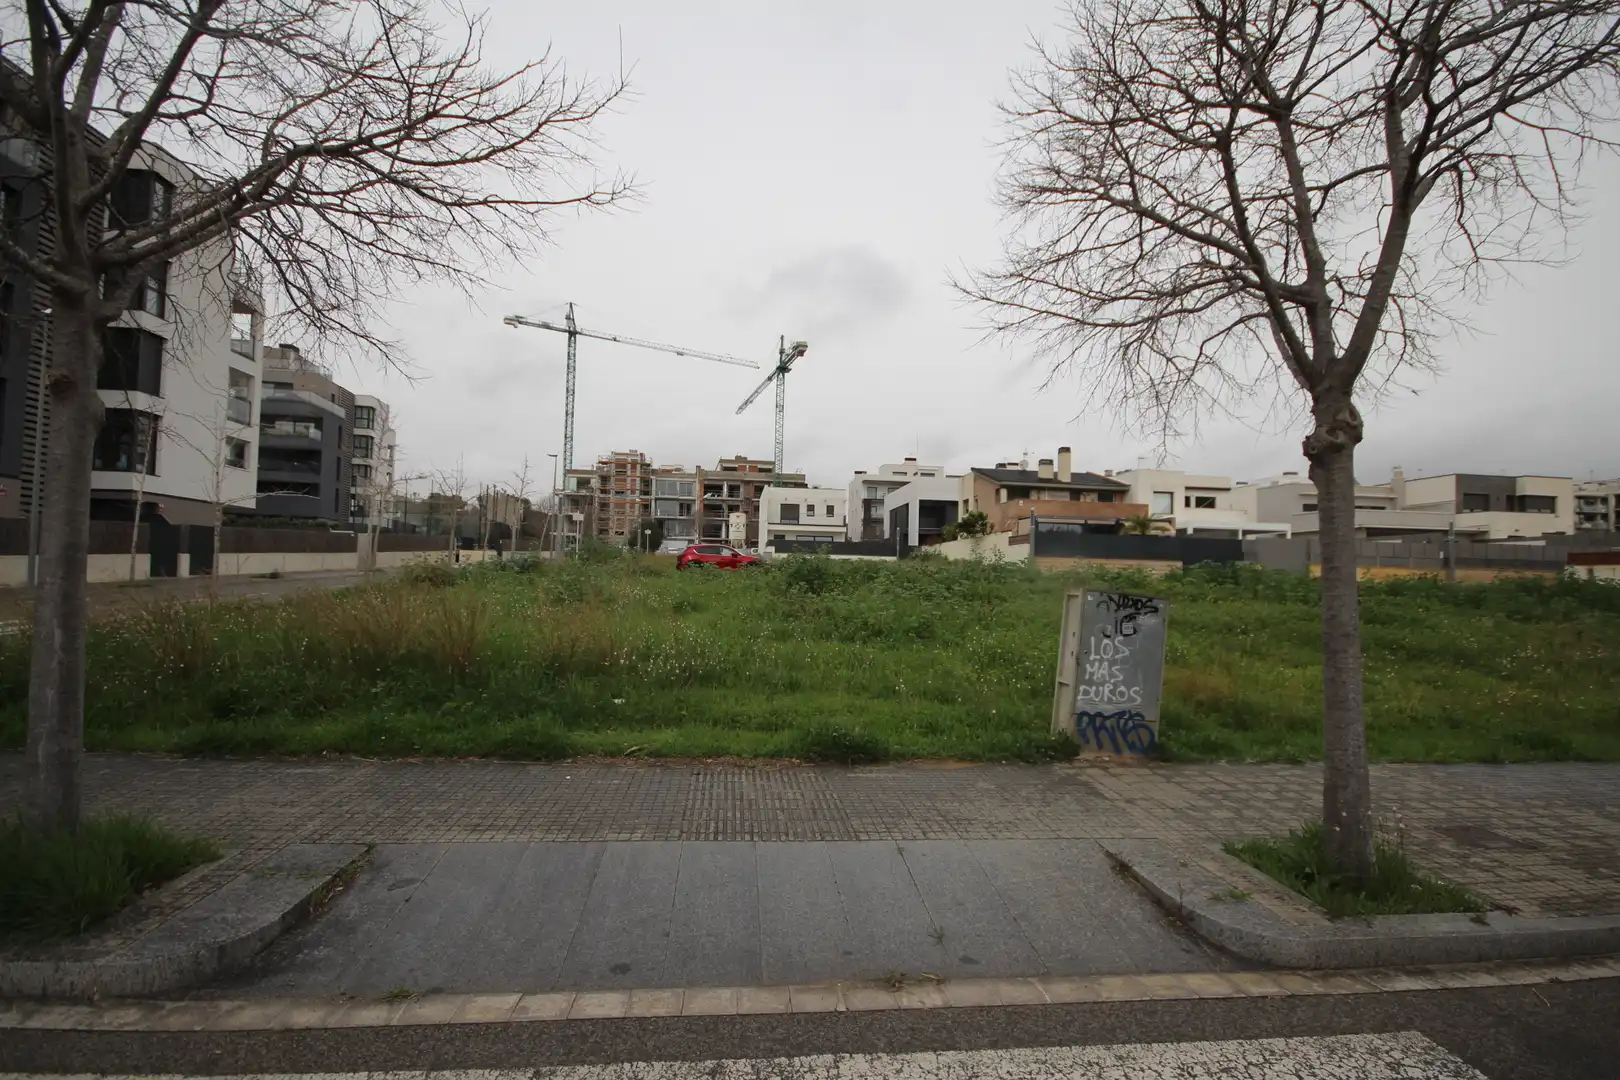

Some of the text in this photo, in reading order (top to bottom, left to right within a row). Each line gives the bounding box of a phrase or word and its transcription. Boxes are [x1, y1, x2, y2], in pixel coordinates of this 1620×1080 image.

[1089, 636, 1130, 660] LOS
[1085, 661, 1124, 684] MAS
[1077, 683, 1142, 705] DUROS
